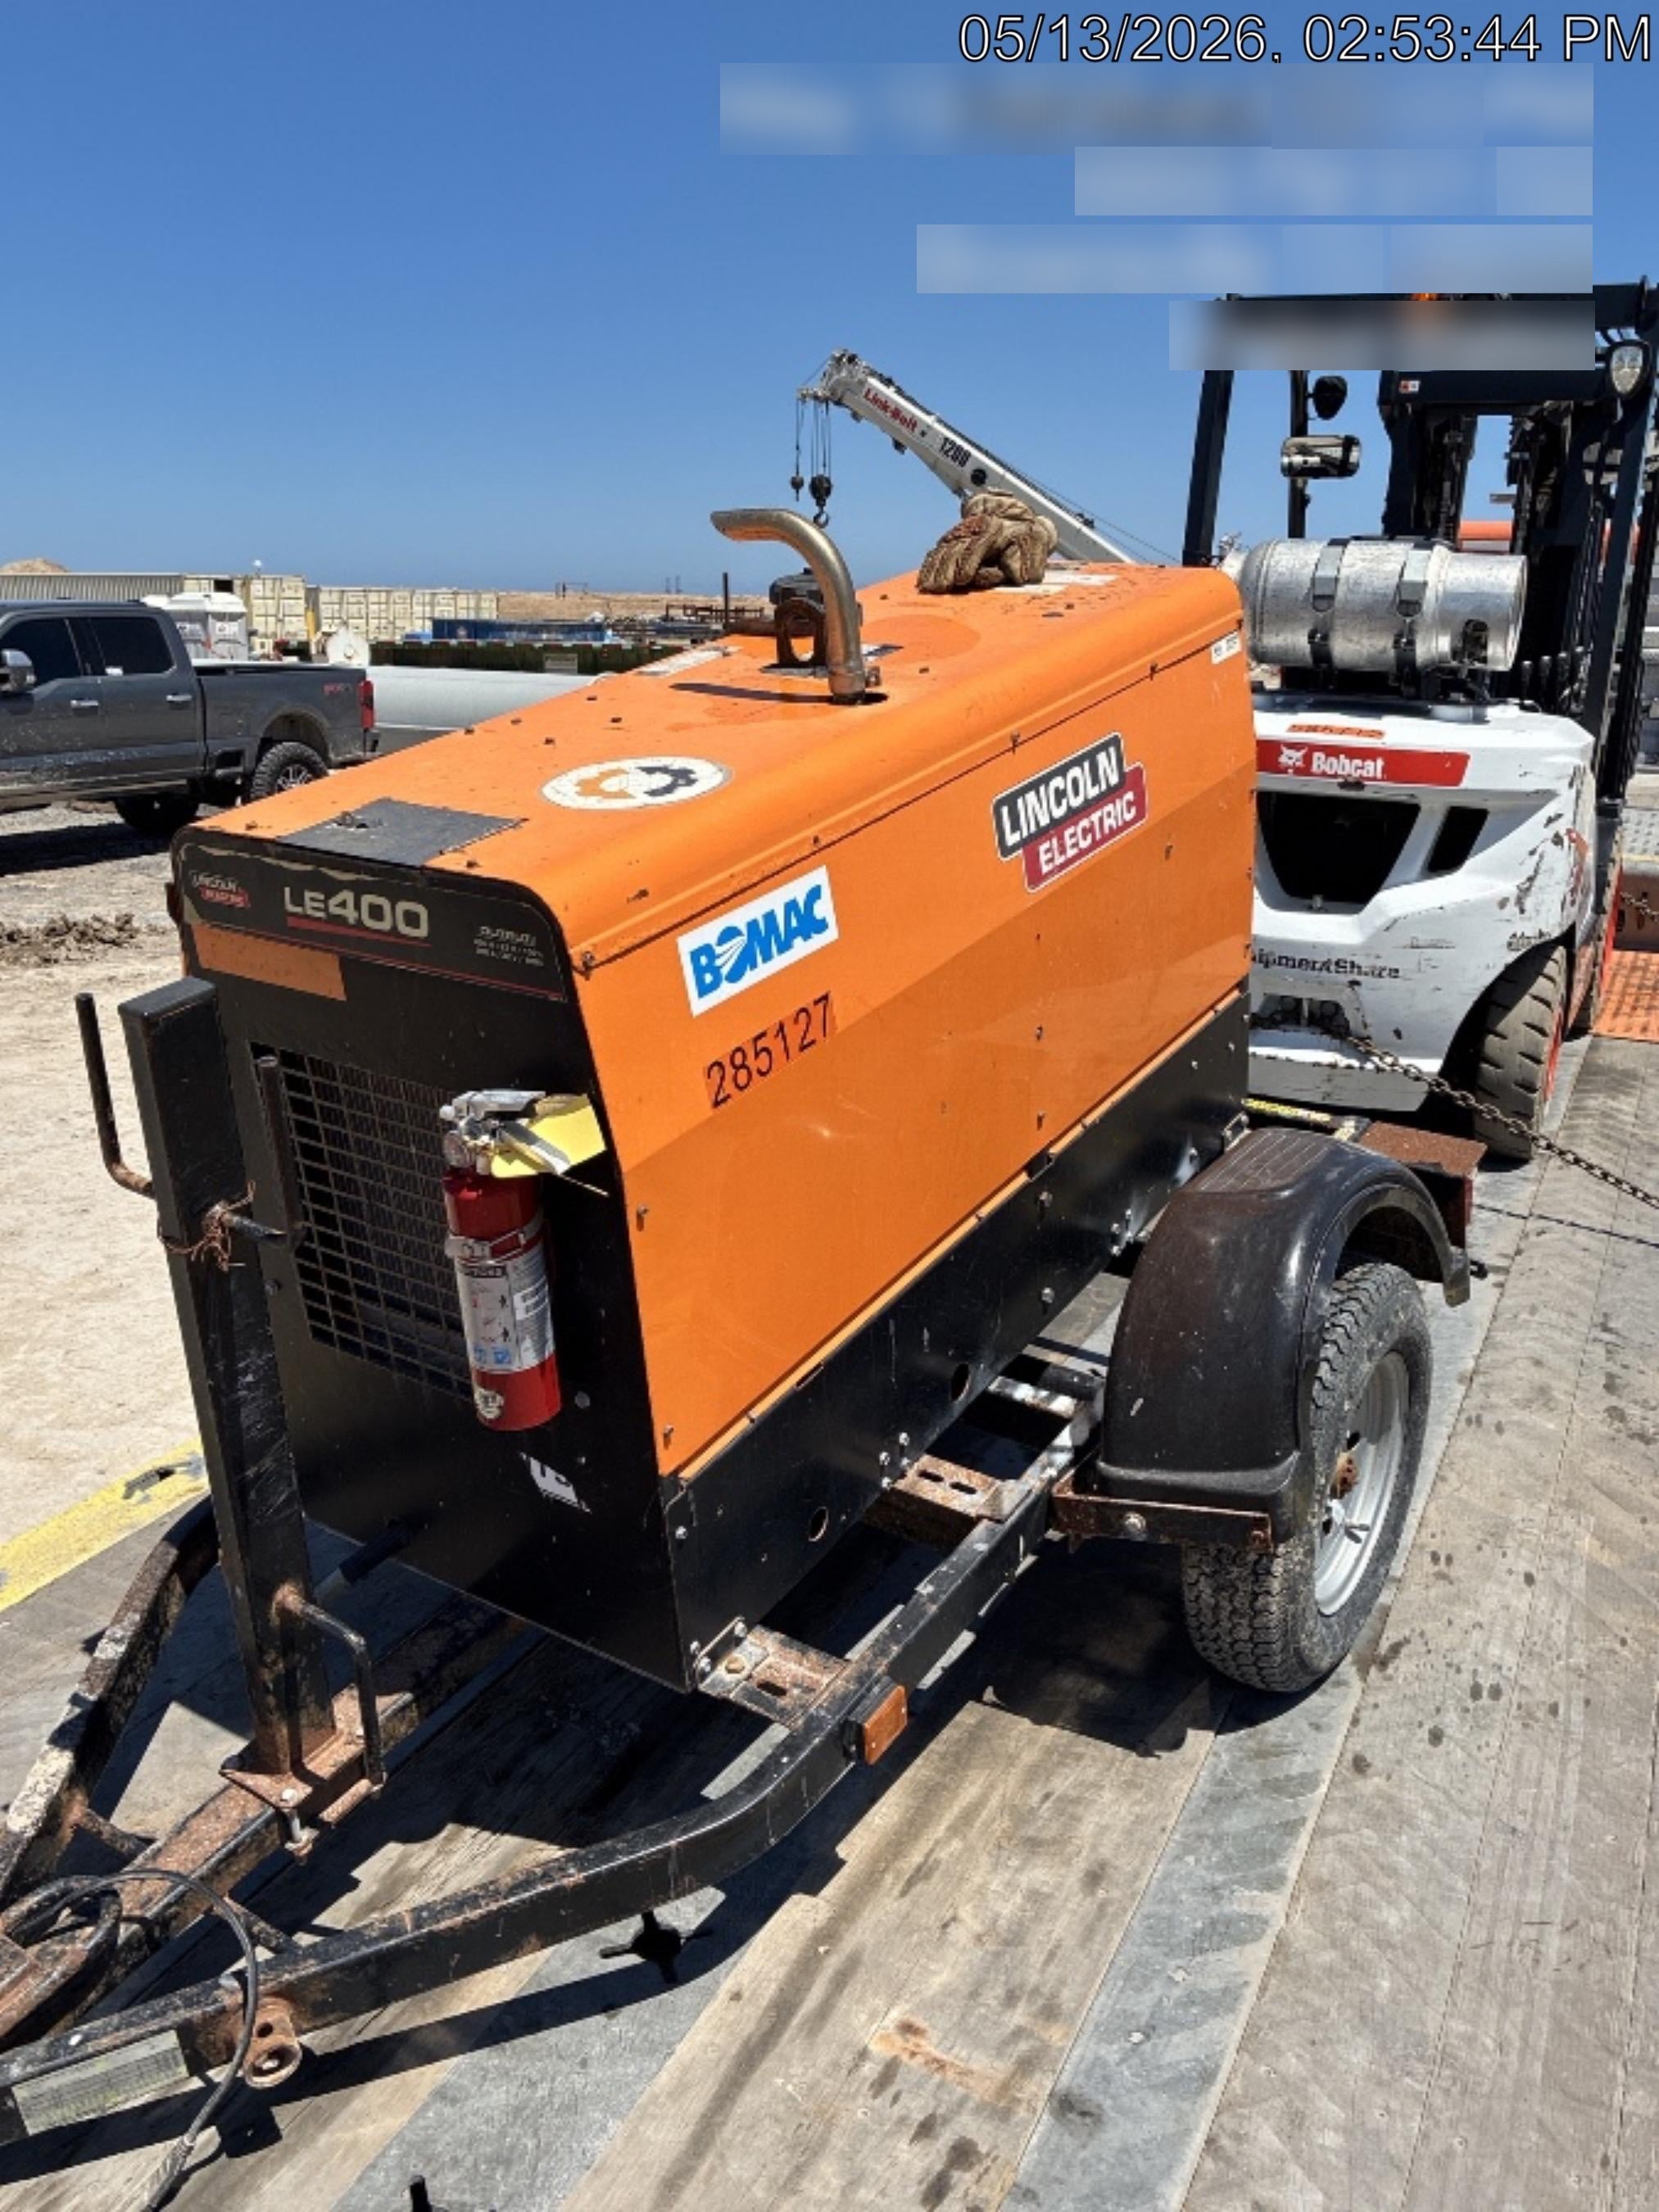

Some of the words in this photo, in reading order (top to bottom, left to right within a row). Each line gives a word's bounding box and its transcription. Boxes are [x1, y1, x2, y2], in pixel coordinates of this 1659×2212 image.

[1001, 745, 1121, 849] LINCOLN
[1312, 751, 1385, 779] Bobcat
[1039, 791, 1137, 875] ELECTRIC
[284, 886, 429, 938] LE400
[690, 884, 829, 999] BOMAC
[706, 991, 831, 1109] 285127
